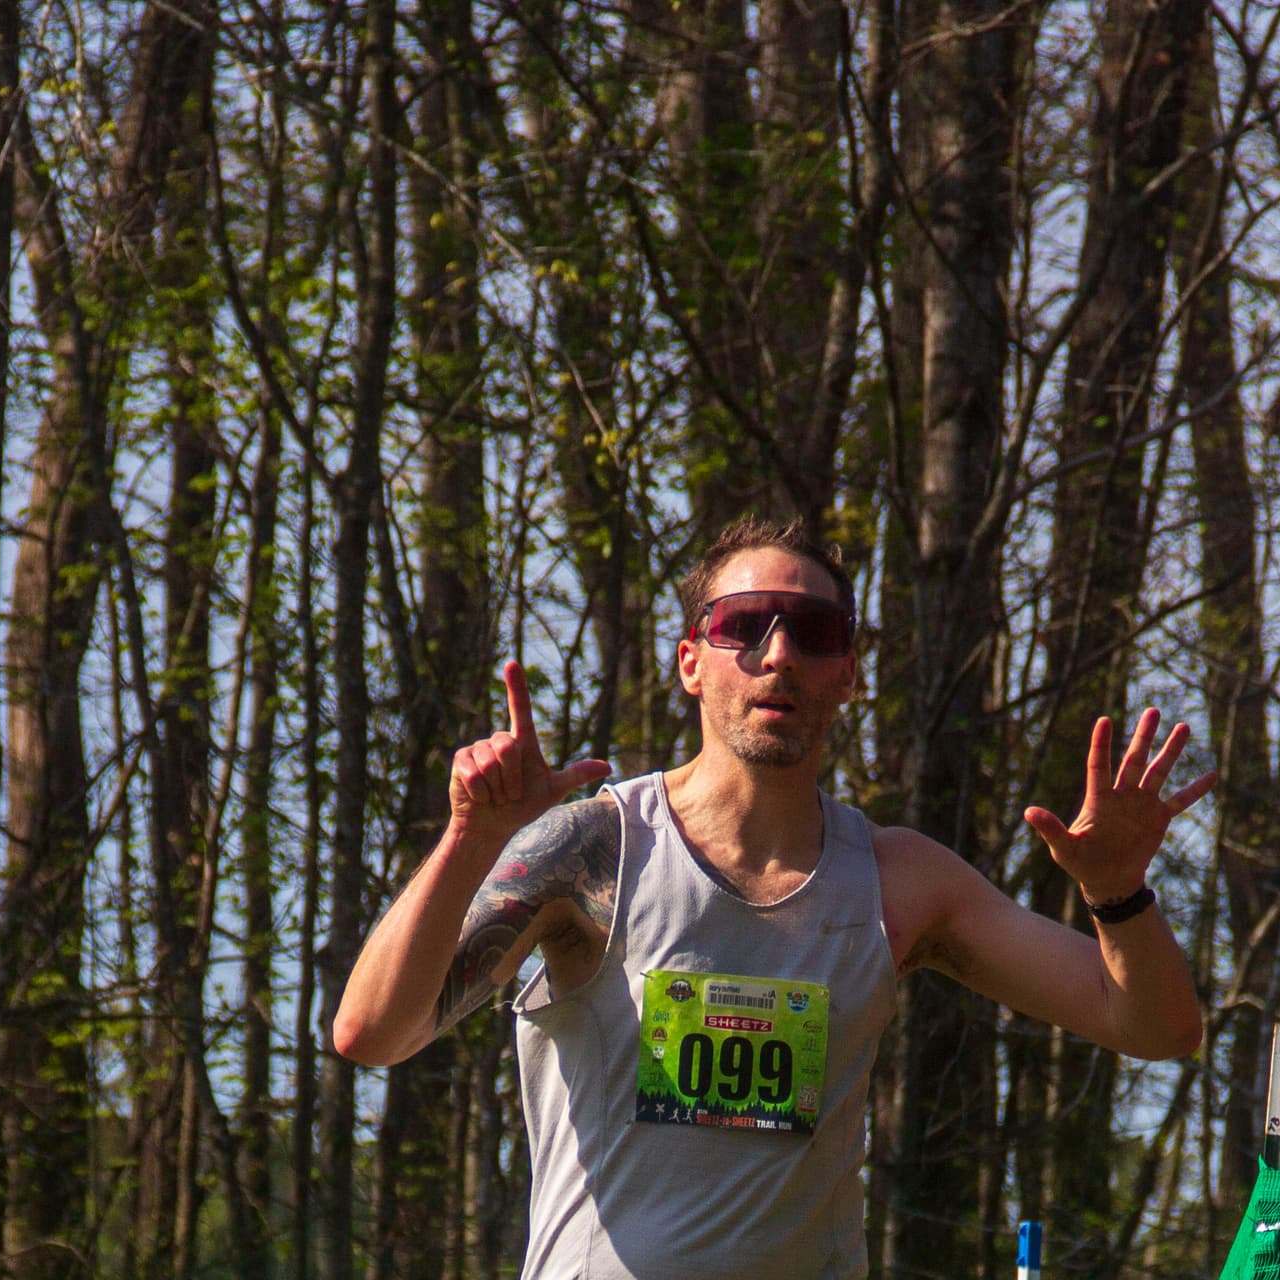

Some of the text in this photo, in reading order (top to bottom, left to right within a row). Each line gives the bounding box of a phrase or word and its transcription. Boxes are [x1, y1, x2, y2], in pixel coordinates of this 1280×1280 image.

[708, 1017, 769, 1031] SHEETZ
[678, 1033, 793, 1104] 099
[756, 1119, 777, 1129] TRAIL
